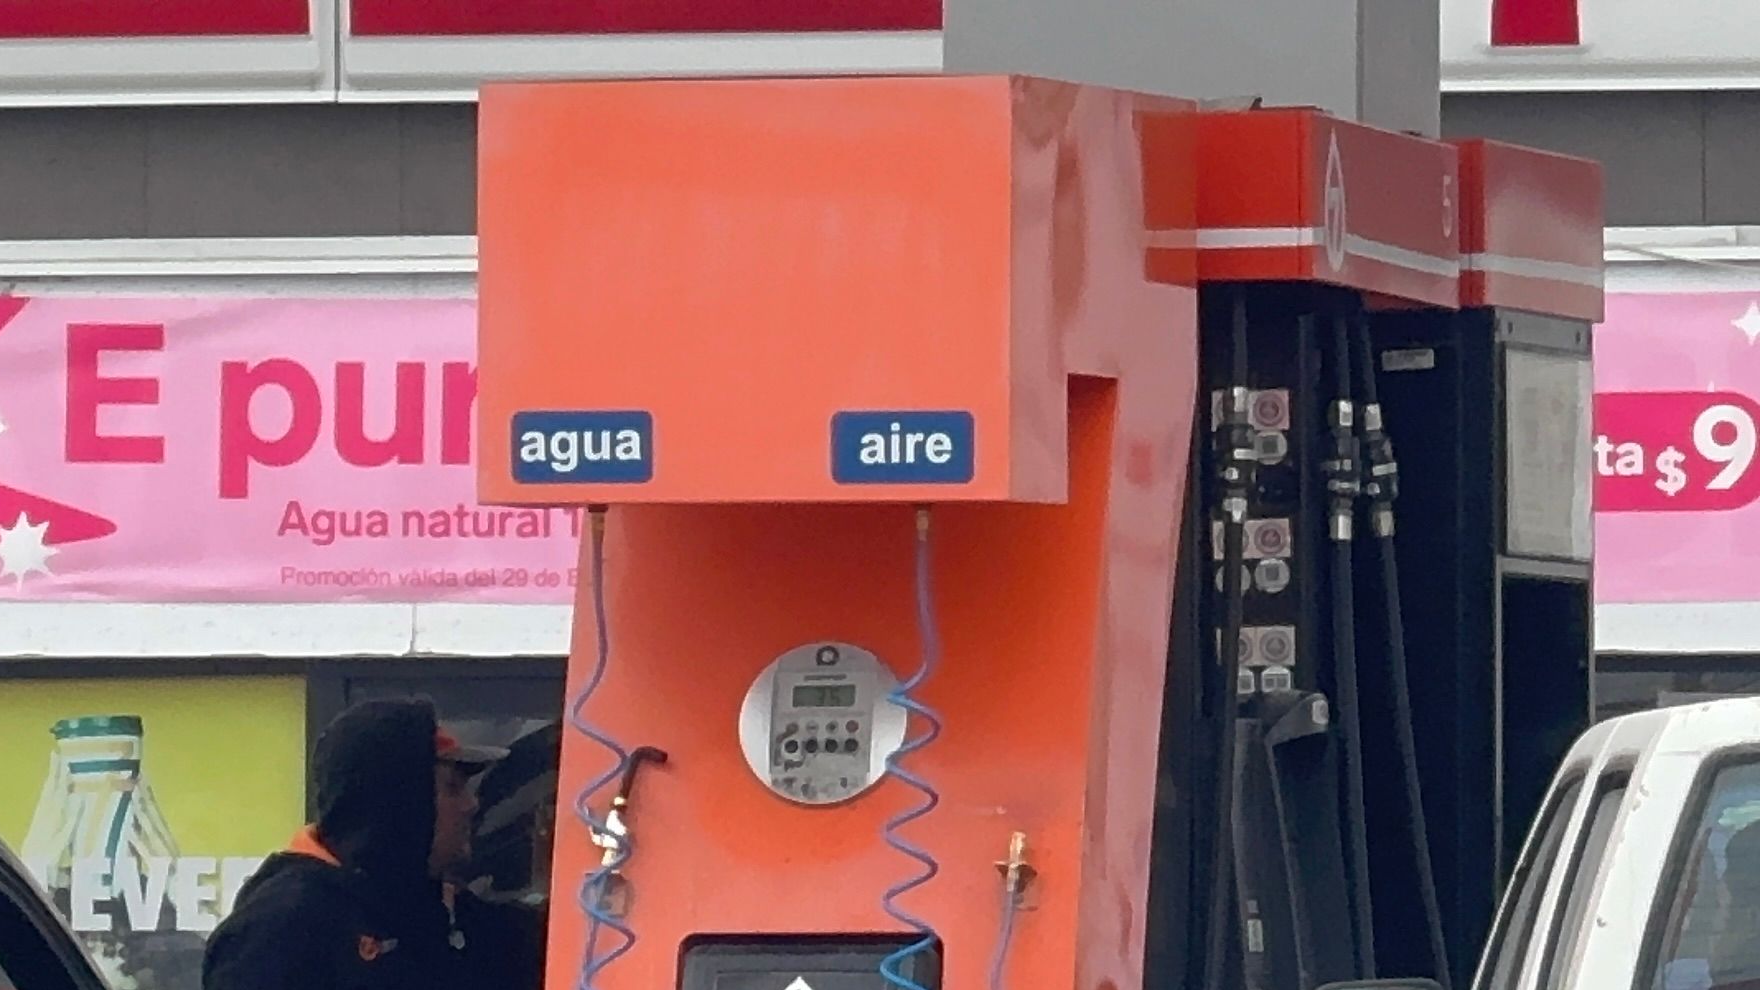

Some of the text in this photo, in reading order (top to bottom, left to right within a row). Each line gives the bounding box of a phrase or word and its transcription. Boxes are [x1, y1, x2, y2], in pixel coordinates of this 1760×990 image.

[64, 323, 165, 464] E
[519, 427, 642, 472] agua
[858, 422, 953, 465] aire
[277, 500, 389, 546] Agua
[402, 502, 550, 538] natural
[280, 565, 391, 588] Promoción
[502, 567, 528, 588] 29
[534, 568, 561, 588] de
